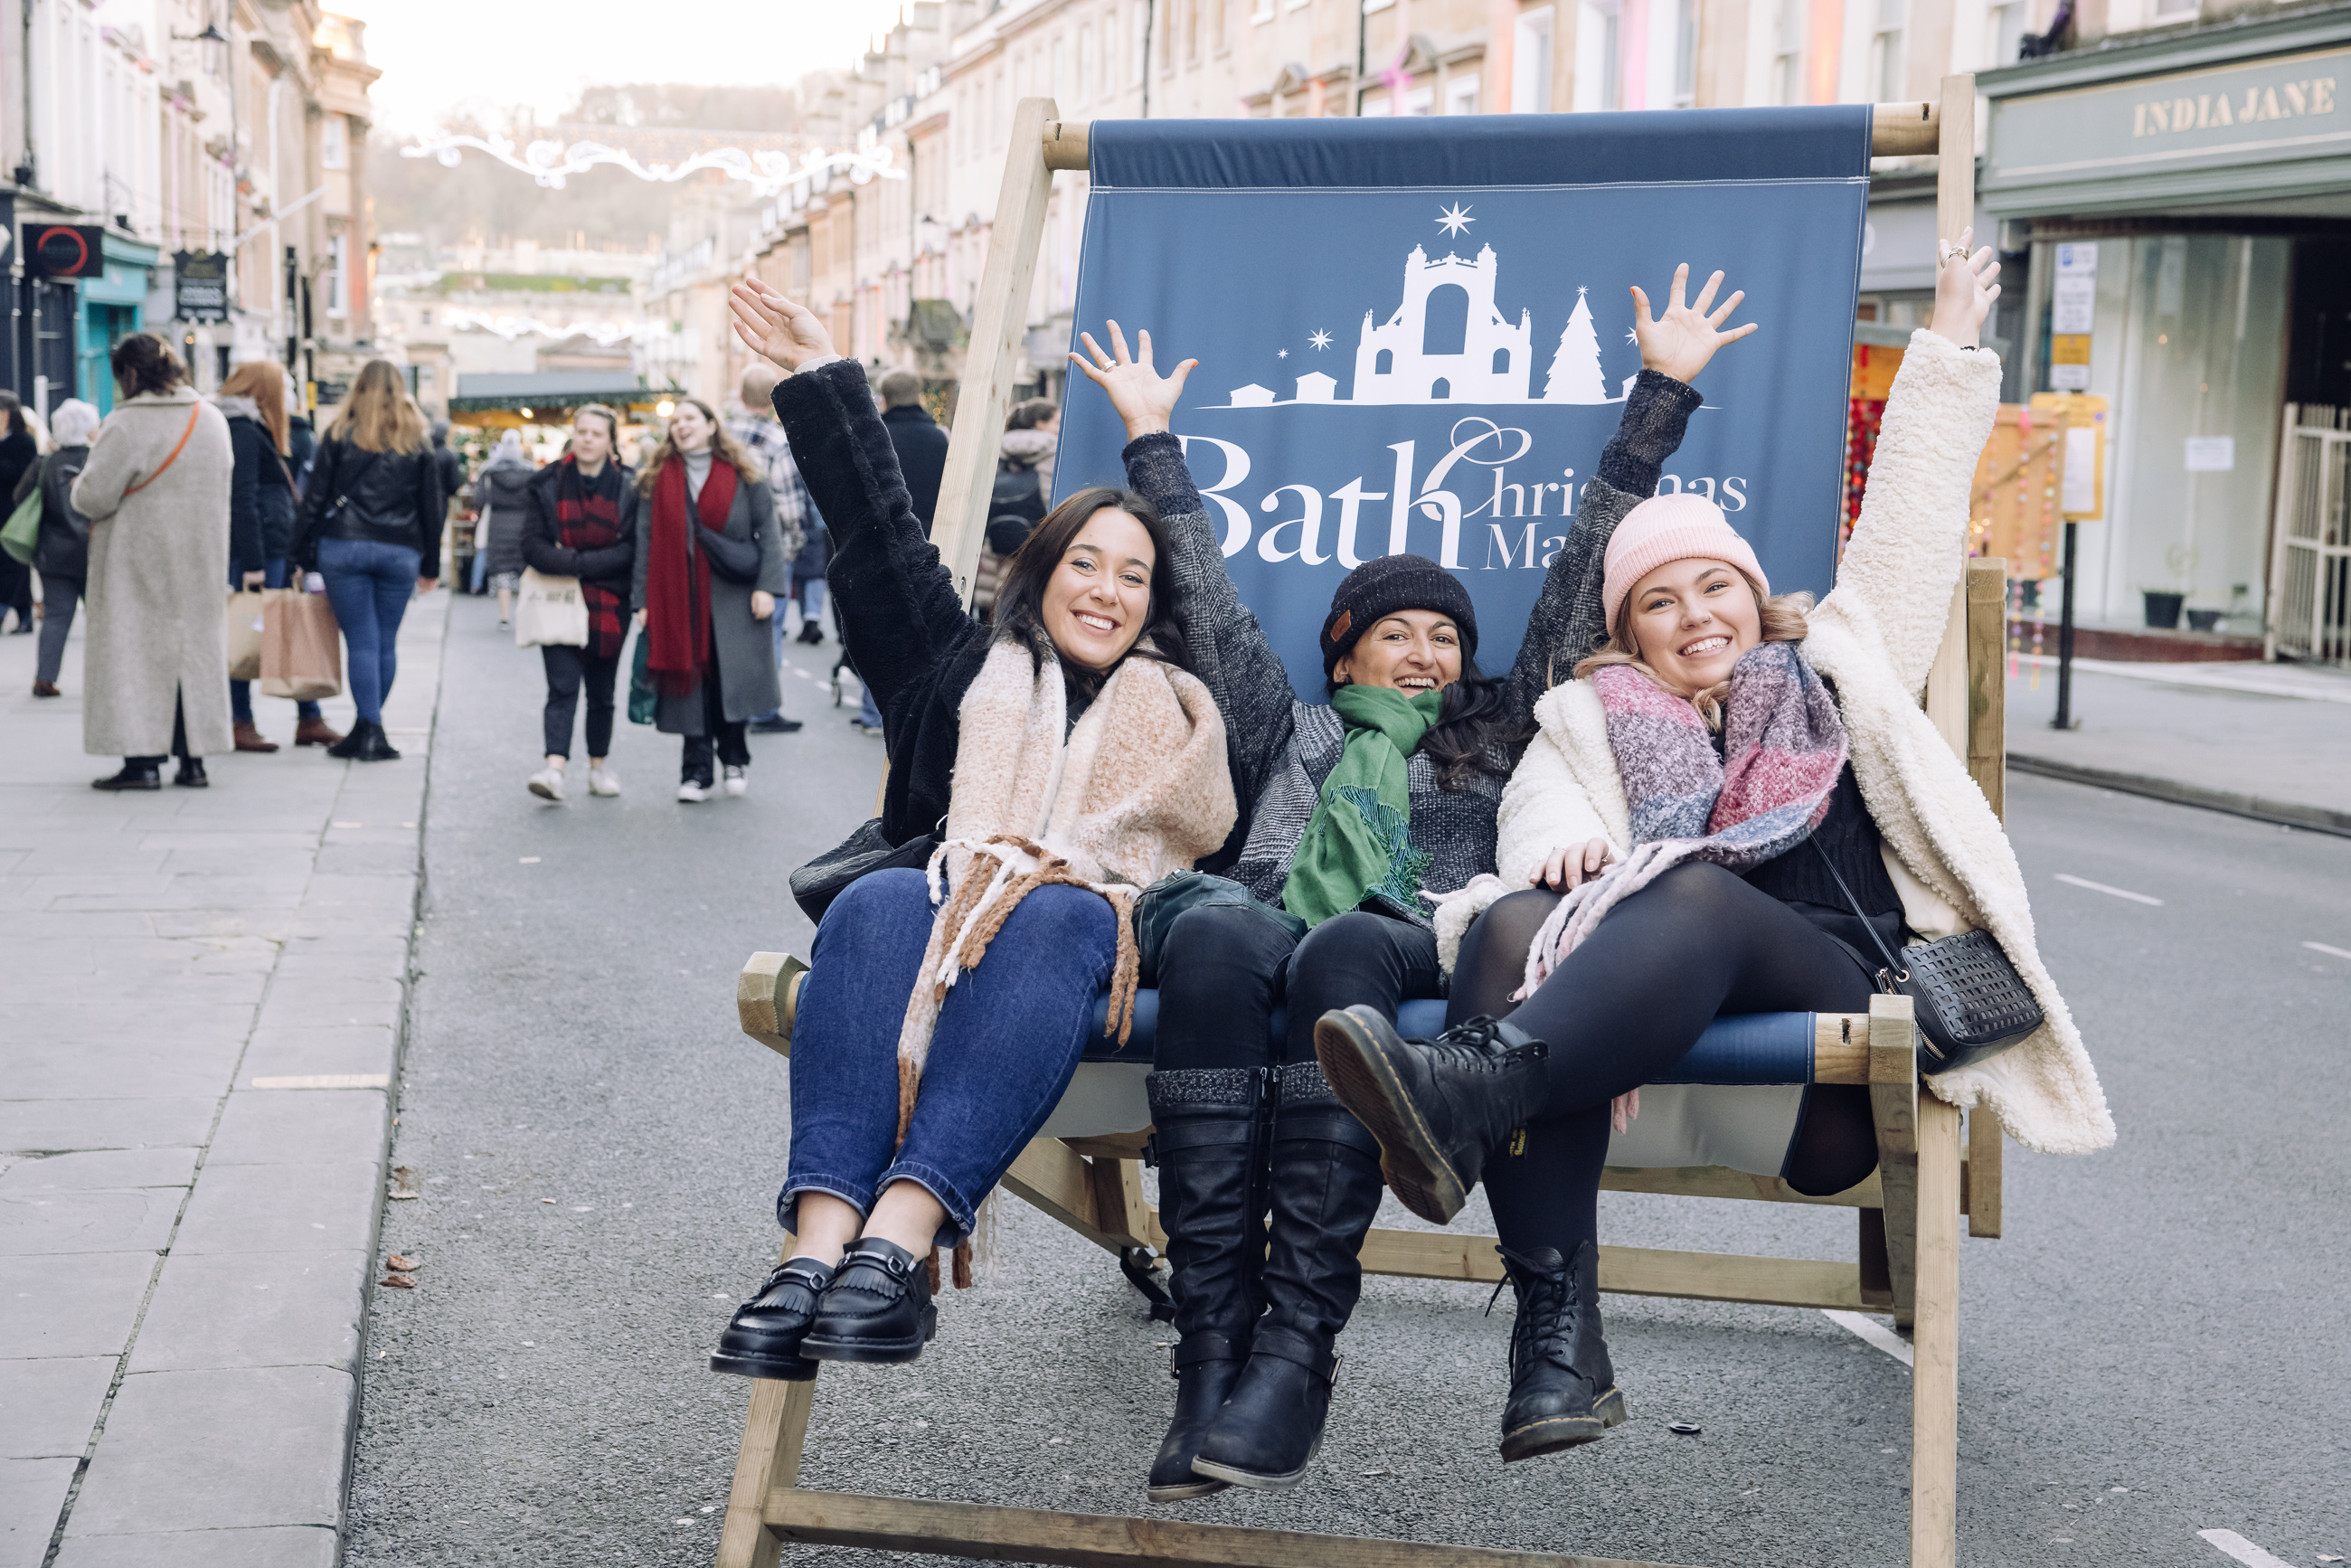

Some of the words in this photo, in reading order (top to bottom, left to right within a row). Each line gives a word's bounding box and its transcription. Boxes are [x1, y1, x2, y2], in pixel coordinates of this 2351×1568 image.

[2133, 92, 2233, 137] INDIA
[2238, 77, 2337, 124] JANE
[1176, 435, 1468, 570] Bath
[1420, 416, 1747, 522] Chrias
